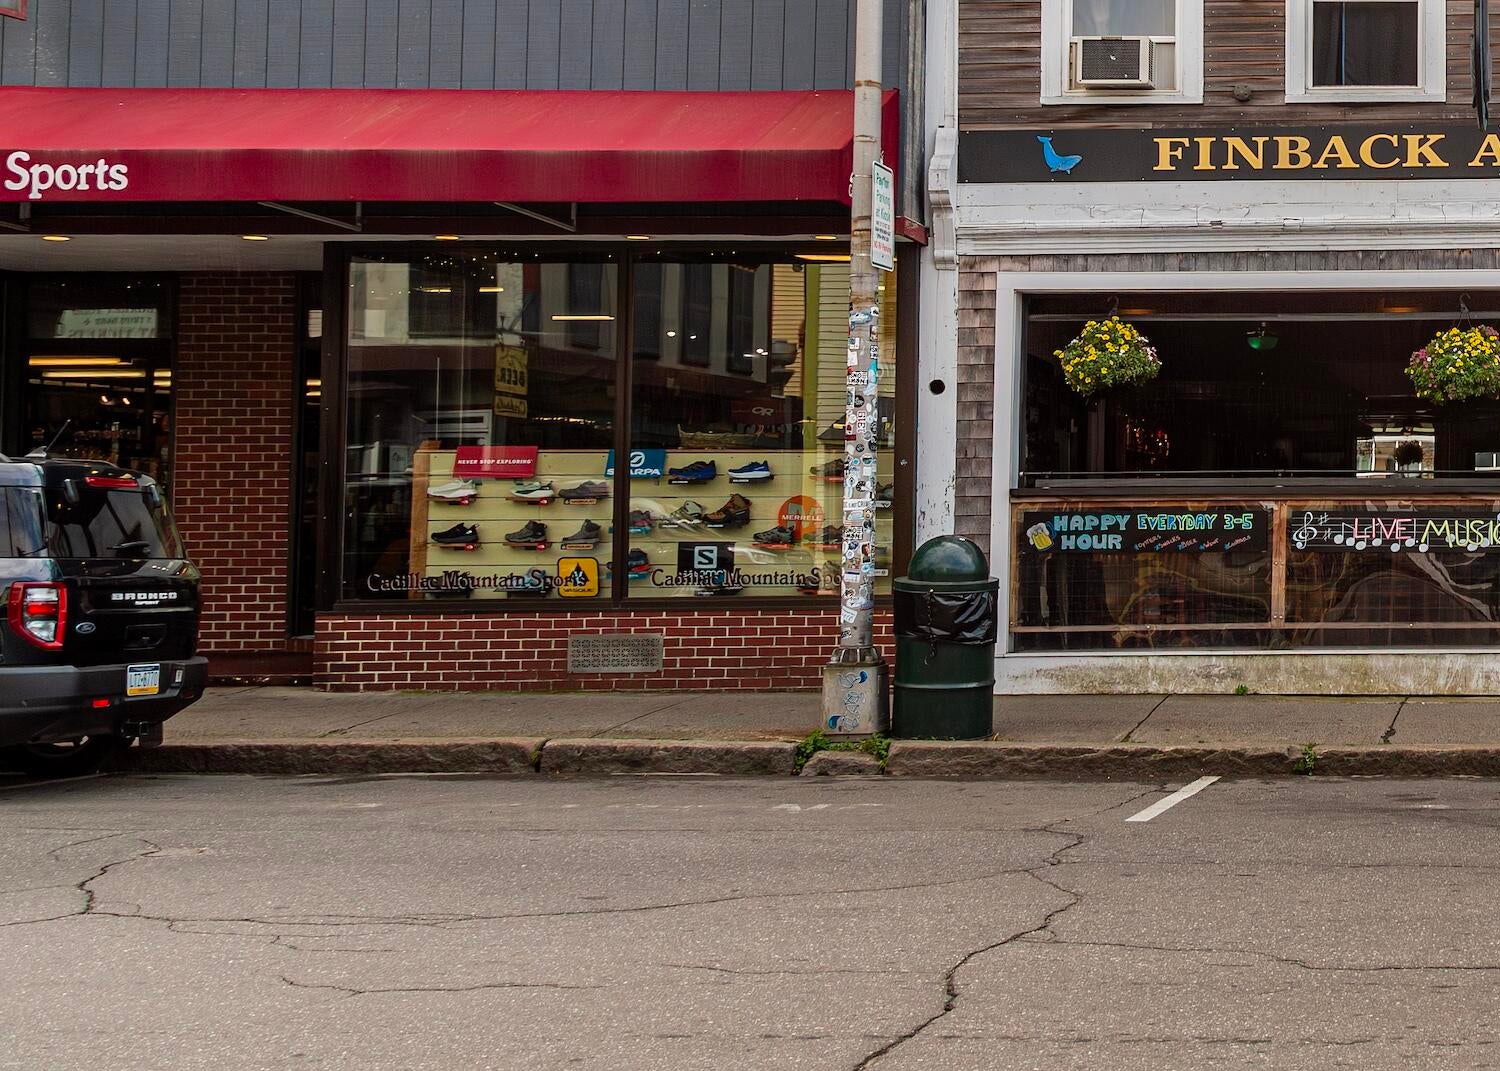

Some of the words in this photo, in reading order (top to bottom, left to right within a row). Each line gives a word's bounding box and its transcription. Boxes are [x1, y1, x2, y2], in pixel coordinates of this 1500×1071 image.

[1152, 133, 1450, 172] FINBACK
[4, 151, 129, 200] Sports
[1053, 514, 1131, 531] HAPPY
[1137, 513, 1217, 530] EVERYDAY
[1223, 513, 1254, 530] 3-5
[1353, 518, 1413, 540] LIVE
[1060, 534, 1123, 550] HOUR
[367, 571, 438, 592] Cadillac
[442, 570, 525, 592] Mountain
[527, 569, 587, 595] Sports
[650, 569, 724, 587] Cadillac
[725, 568, 806, 587] Mountain
[806, 567, 842, 590] Spo
[111, 592, 178, 601] BRONCO
